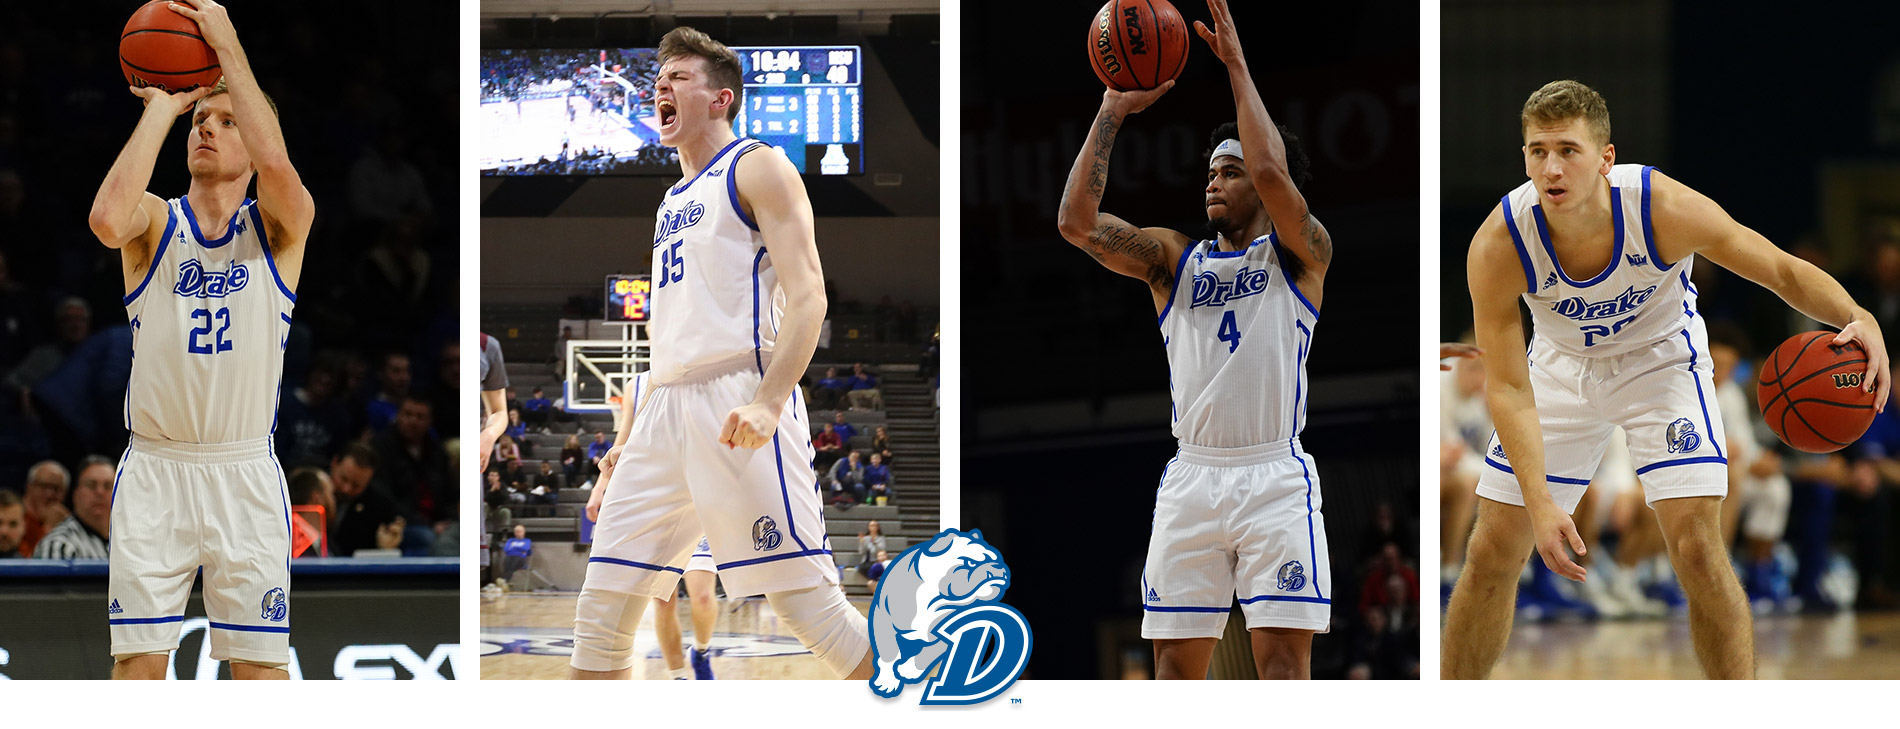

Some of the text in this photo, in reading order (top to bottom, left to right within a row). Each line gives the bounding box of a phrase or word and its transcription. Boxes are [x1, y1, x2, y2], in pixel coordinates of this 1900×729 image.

[1123, 6, 1147, 56] NCAA
[751, 50, 801, 72] 10:04
[624, 294, 646, 319] 12
[1551, 285, 1657, 320] Drake
[188, 307, 232, 354] 22
[1217, 310, 1241, 354] 4
